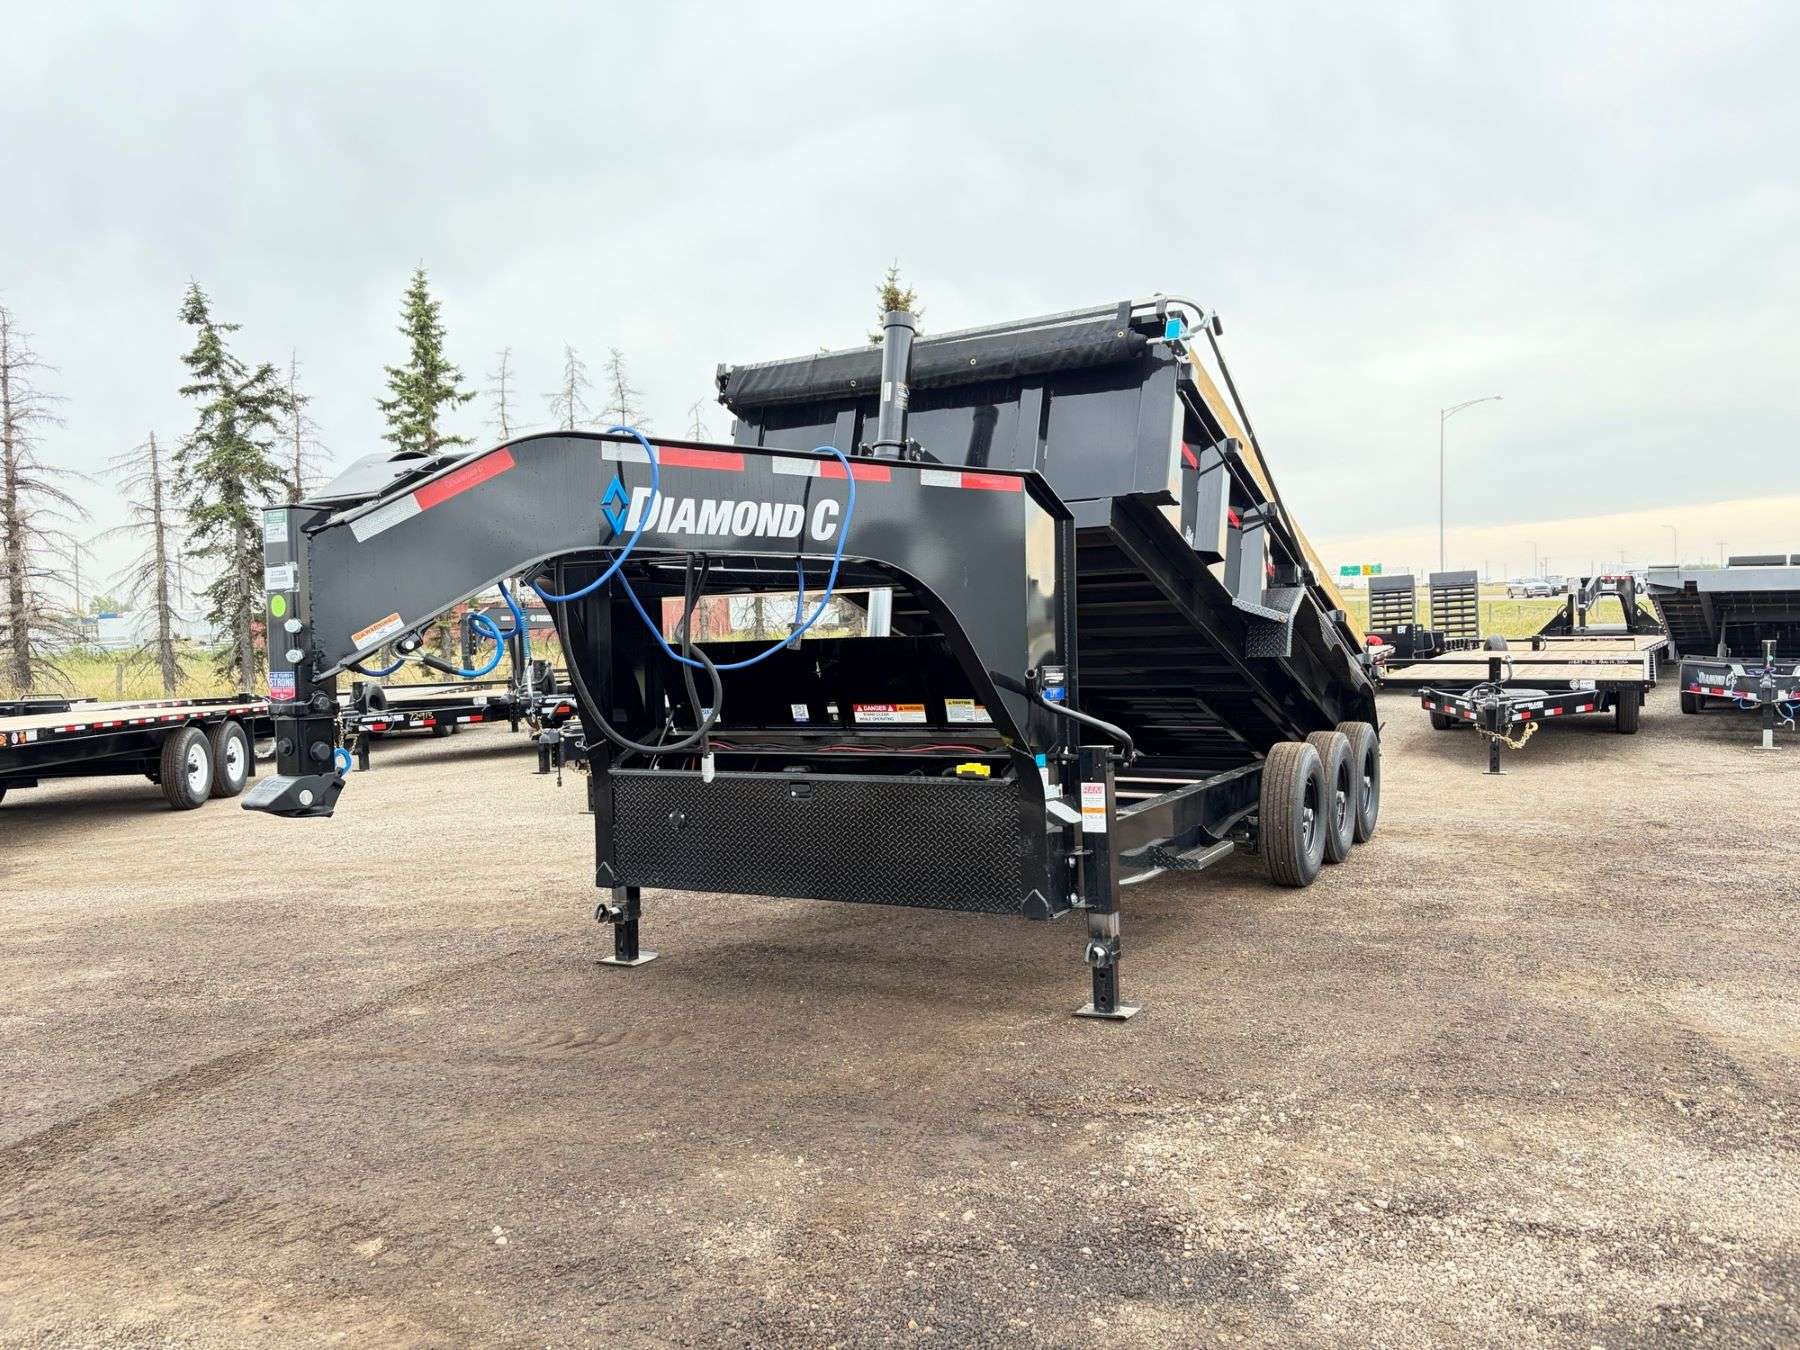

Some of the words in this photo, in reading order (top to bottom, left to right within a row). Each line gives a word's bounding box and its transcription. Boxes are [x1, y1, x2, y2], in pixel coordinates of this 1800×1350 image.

[624, 486, 806, 539] DIAMOND
[811, 498, 840, 541] C
[863, 704, 887, 712] DANGER
